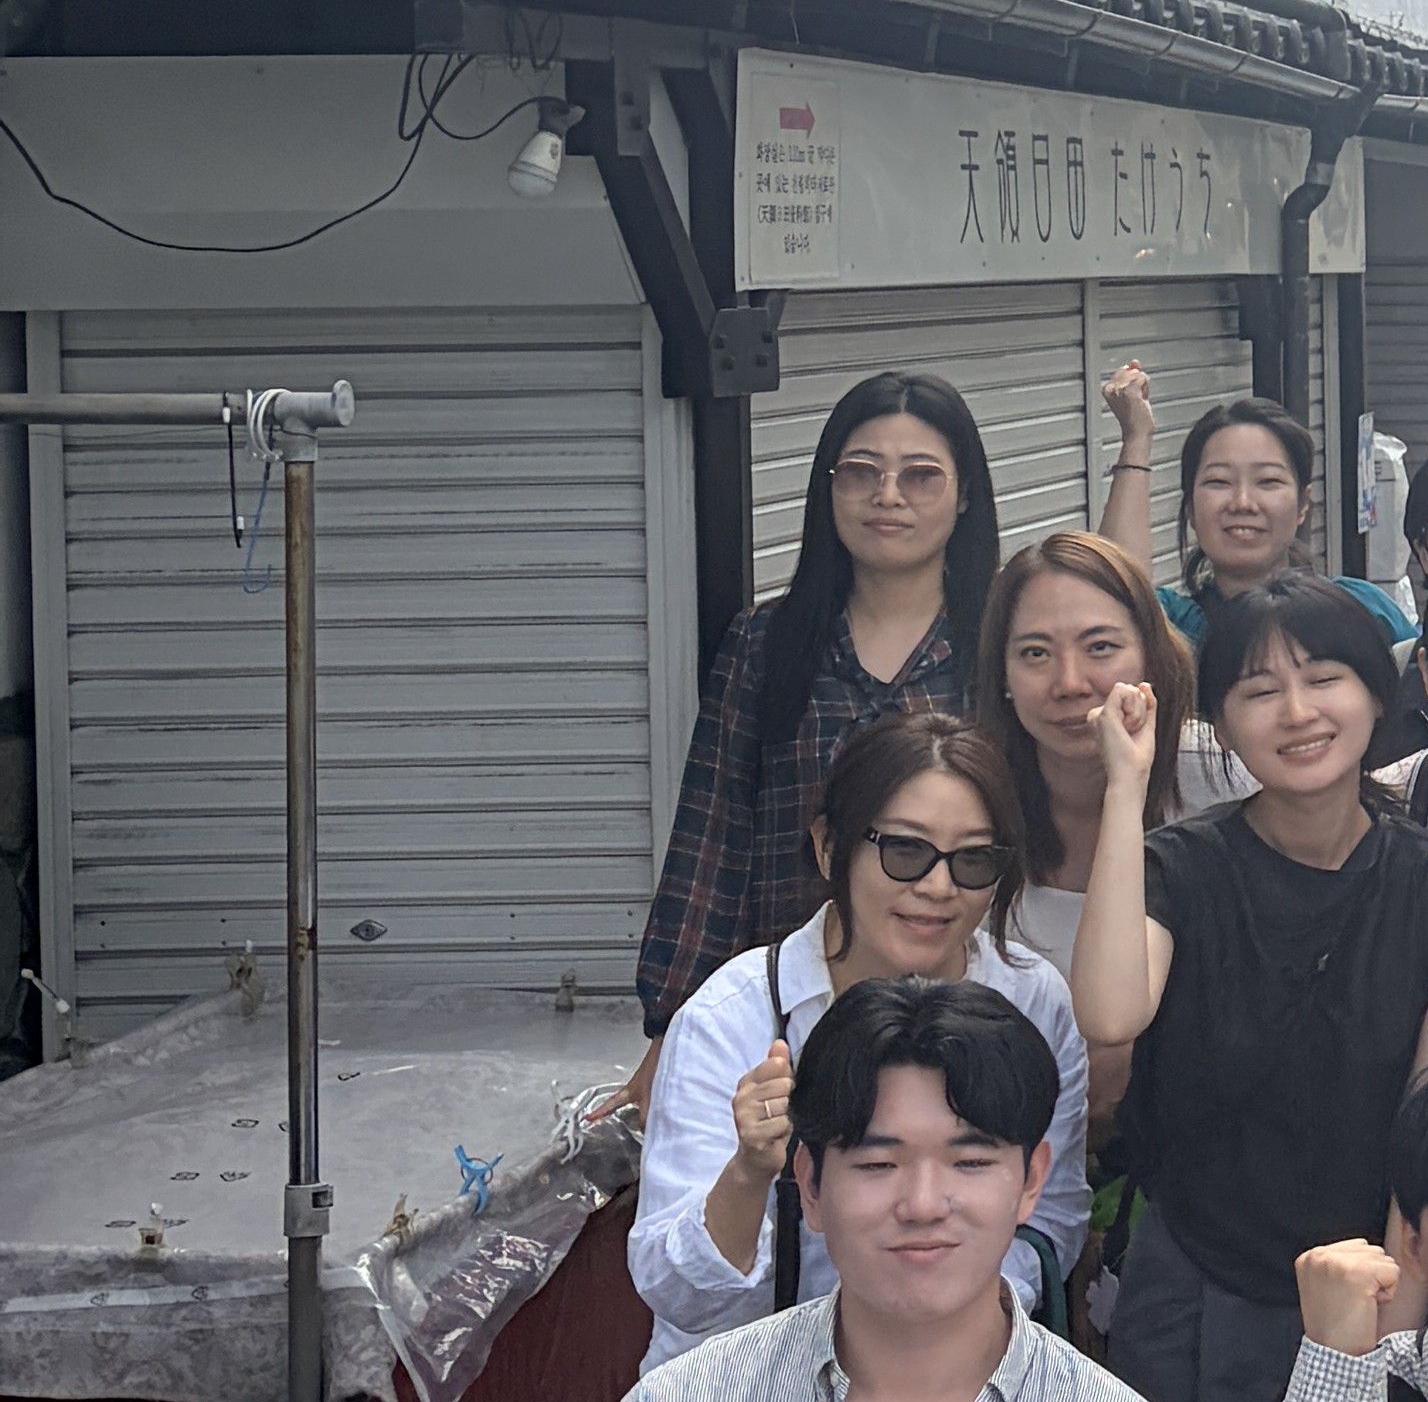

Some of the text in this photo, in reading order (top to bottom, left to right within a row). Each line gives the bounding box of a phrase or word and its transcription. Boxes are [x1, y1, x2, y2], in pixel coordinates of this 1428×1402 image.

[958, 129, 1211, 243] 天領日田 たけうち
